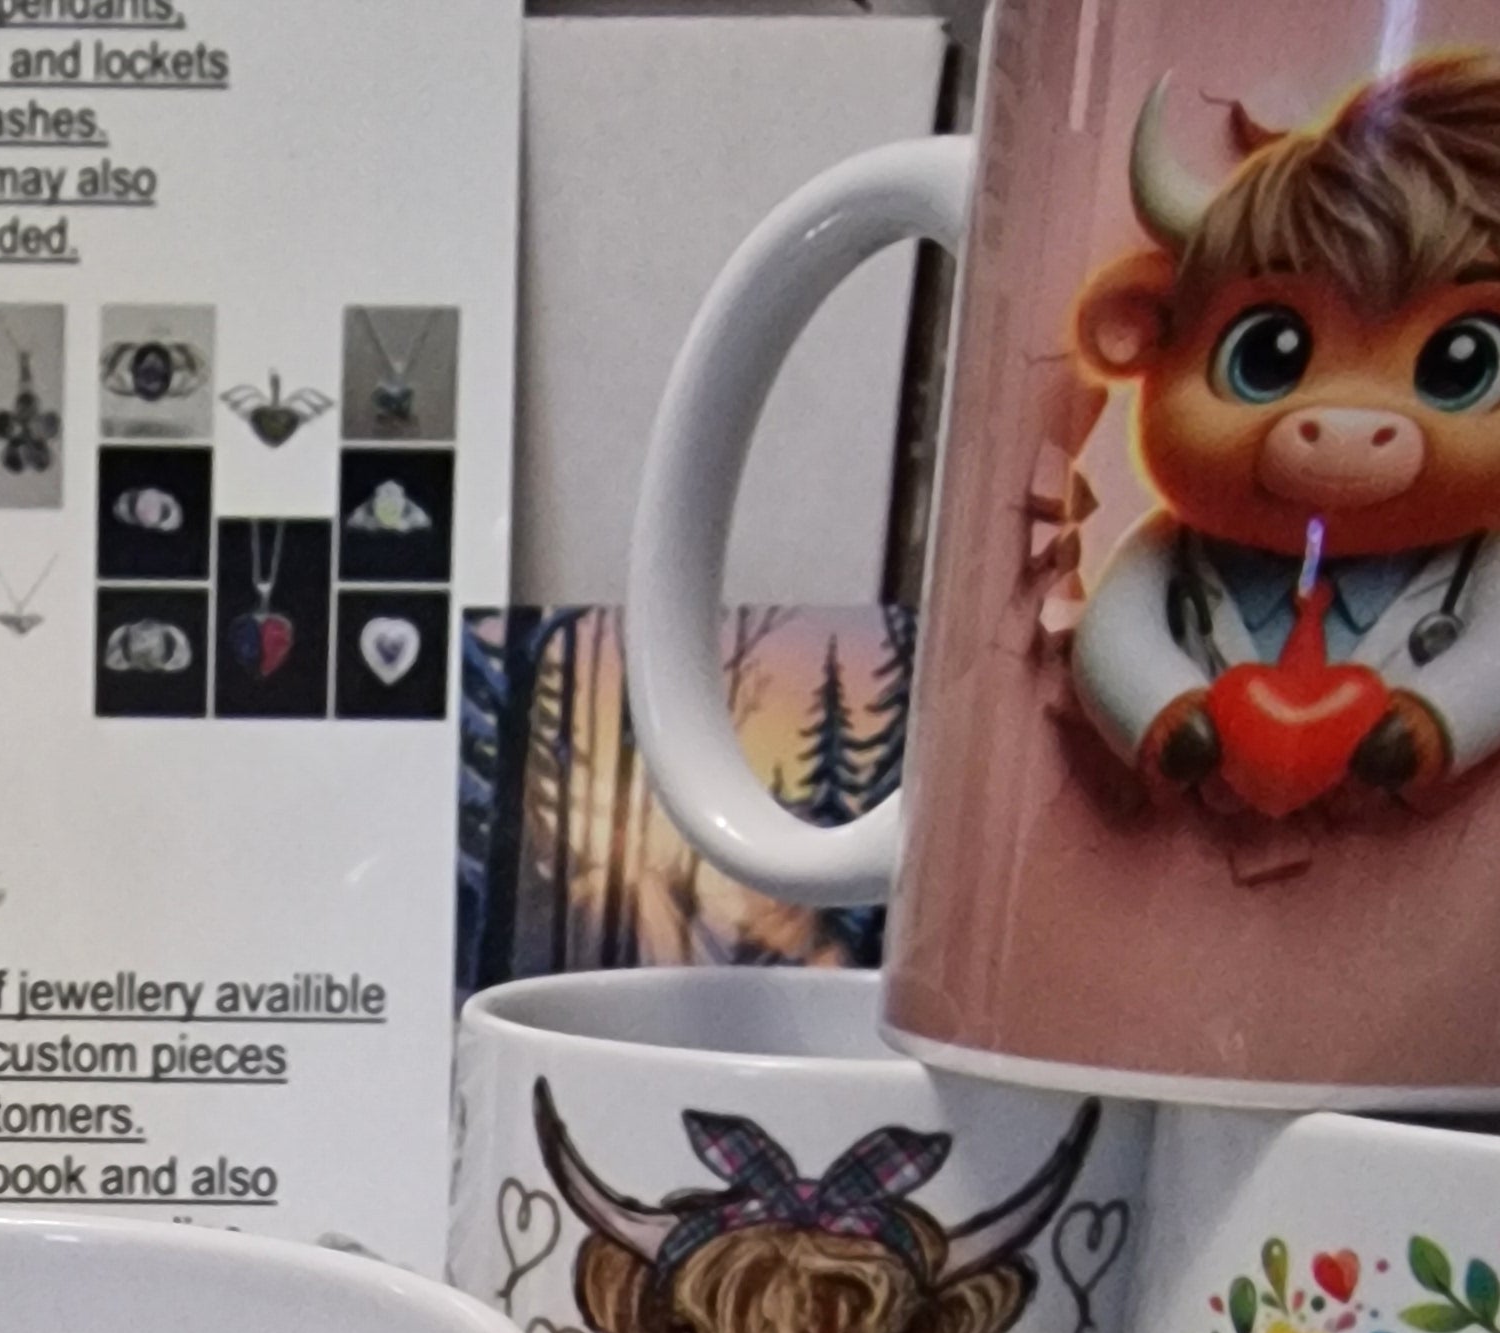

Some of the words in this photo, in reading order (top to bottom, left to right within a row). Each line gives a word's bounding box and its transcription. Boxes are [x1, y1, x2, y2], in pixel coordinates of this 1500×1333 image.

[9, 38, 81, 81] and
[93, 38, 229, 82] lockets
[76, 160, 157, 197] also
[17, 970, 203, 1021] jewellery
[215, 972, 386, 1015] availible
[151, 1034, 288, 1081] pieces
[99, 1156, 177, 1196] and
[191, 1156, 278, 1198] also
